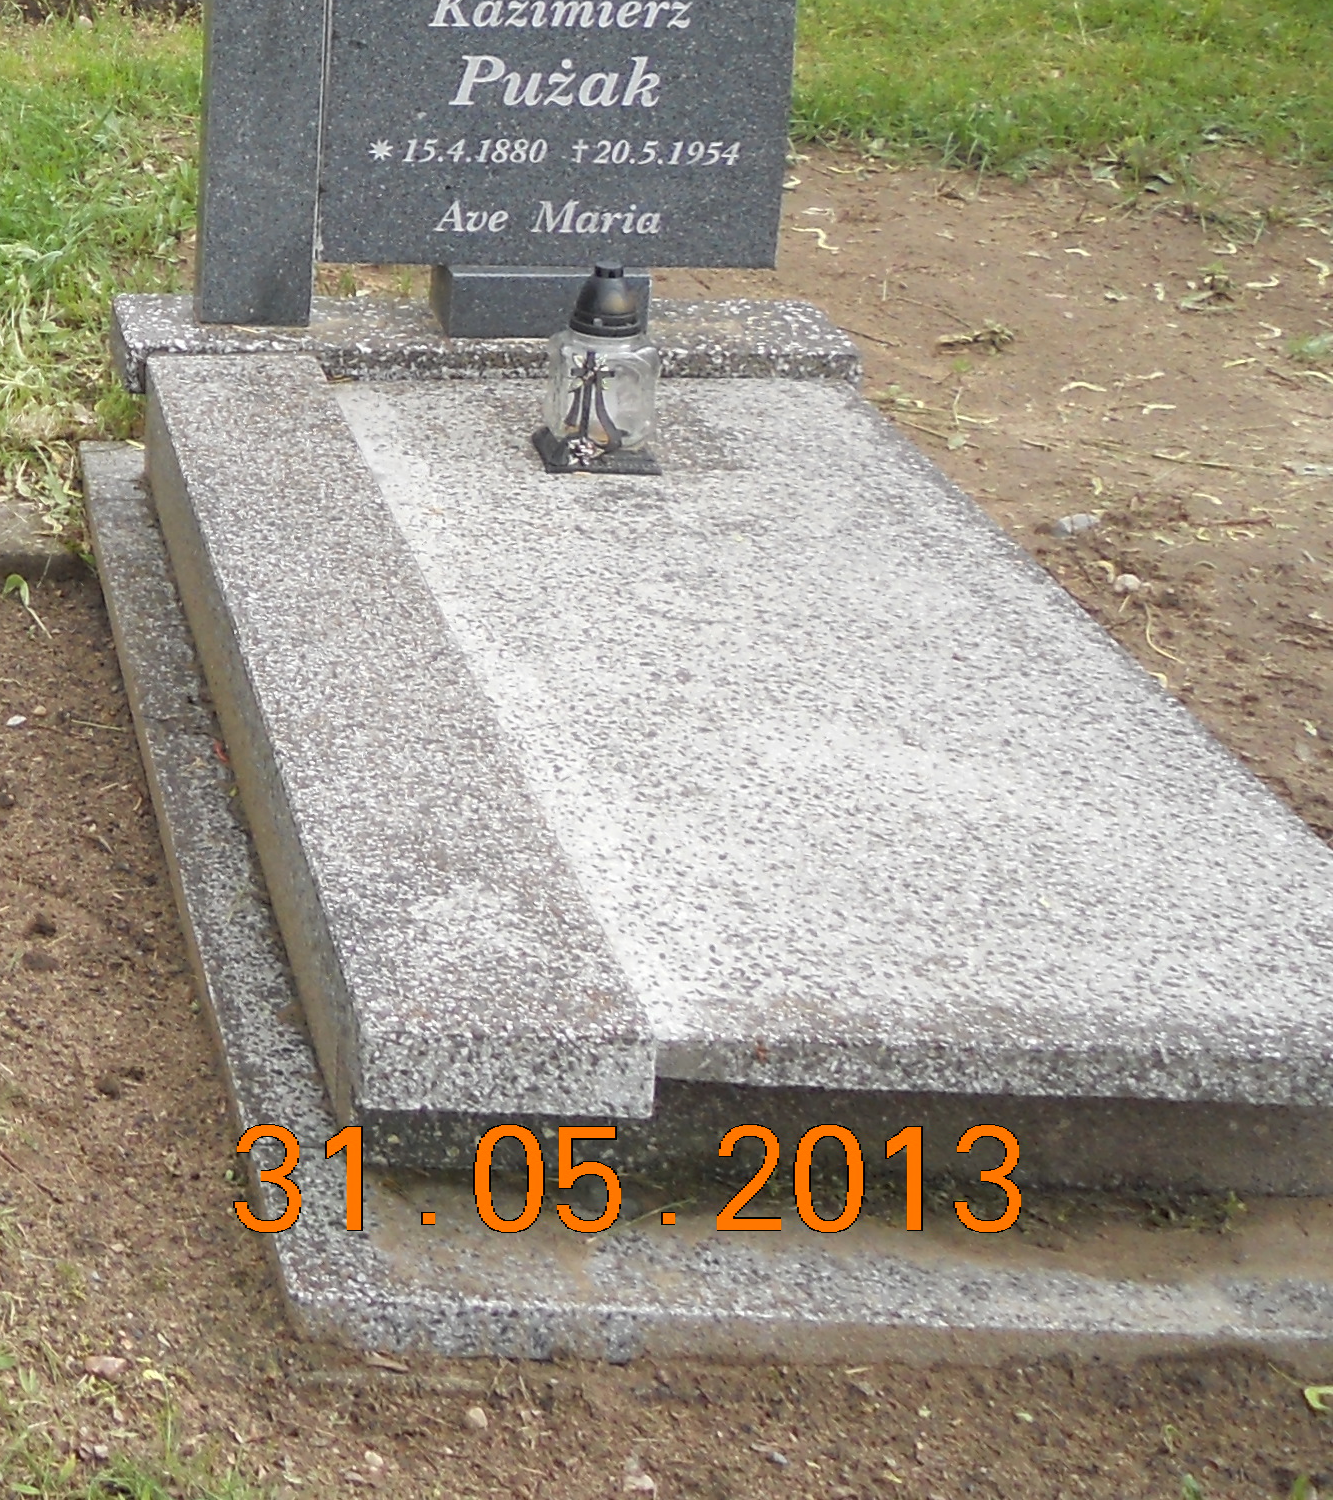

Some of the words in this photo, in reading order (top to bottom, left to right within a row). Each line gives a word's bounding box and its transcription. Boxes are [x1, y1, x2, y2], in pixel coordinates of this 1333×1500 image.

[448, 54, 662, 108] Pużak
[434, 199, 510, 233] Ave
[531, 200, 663, 235] Maria
